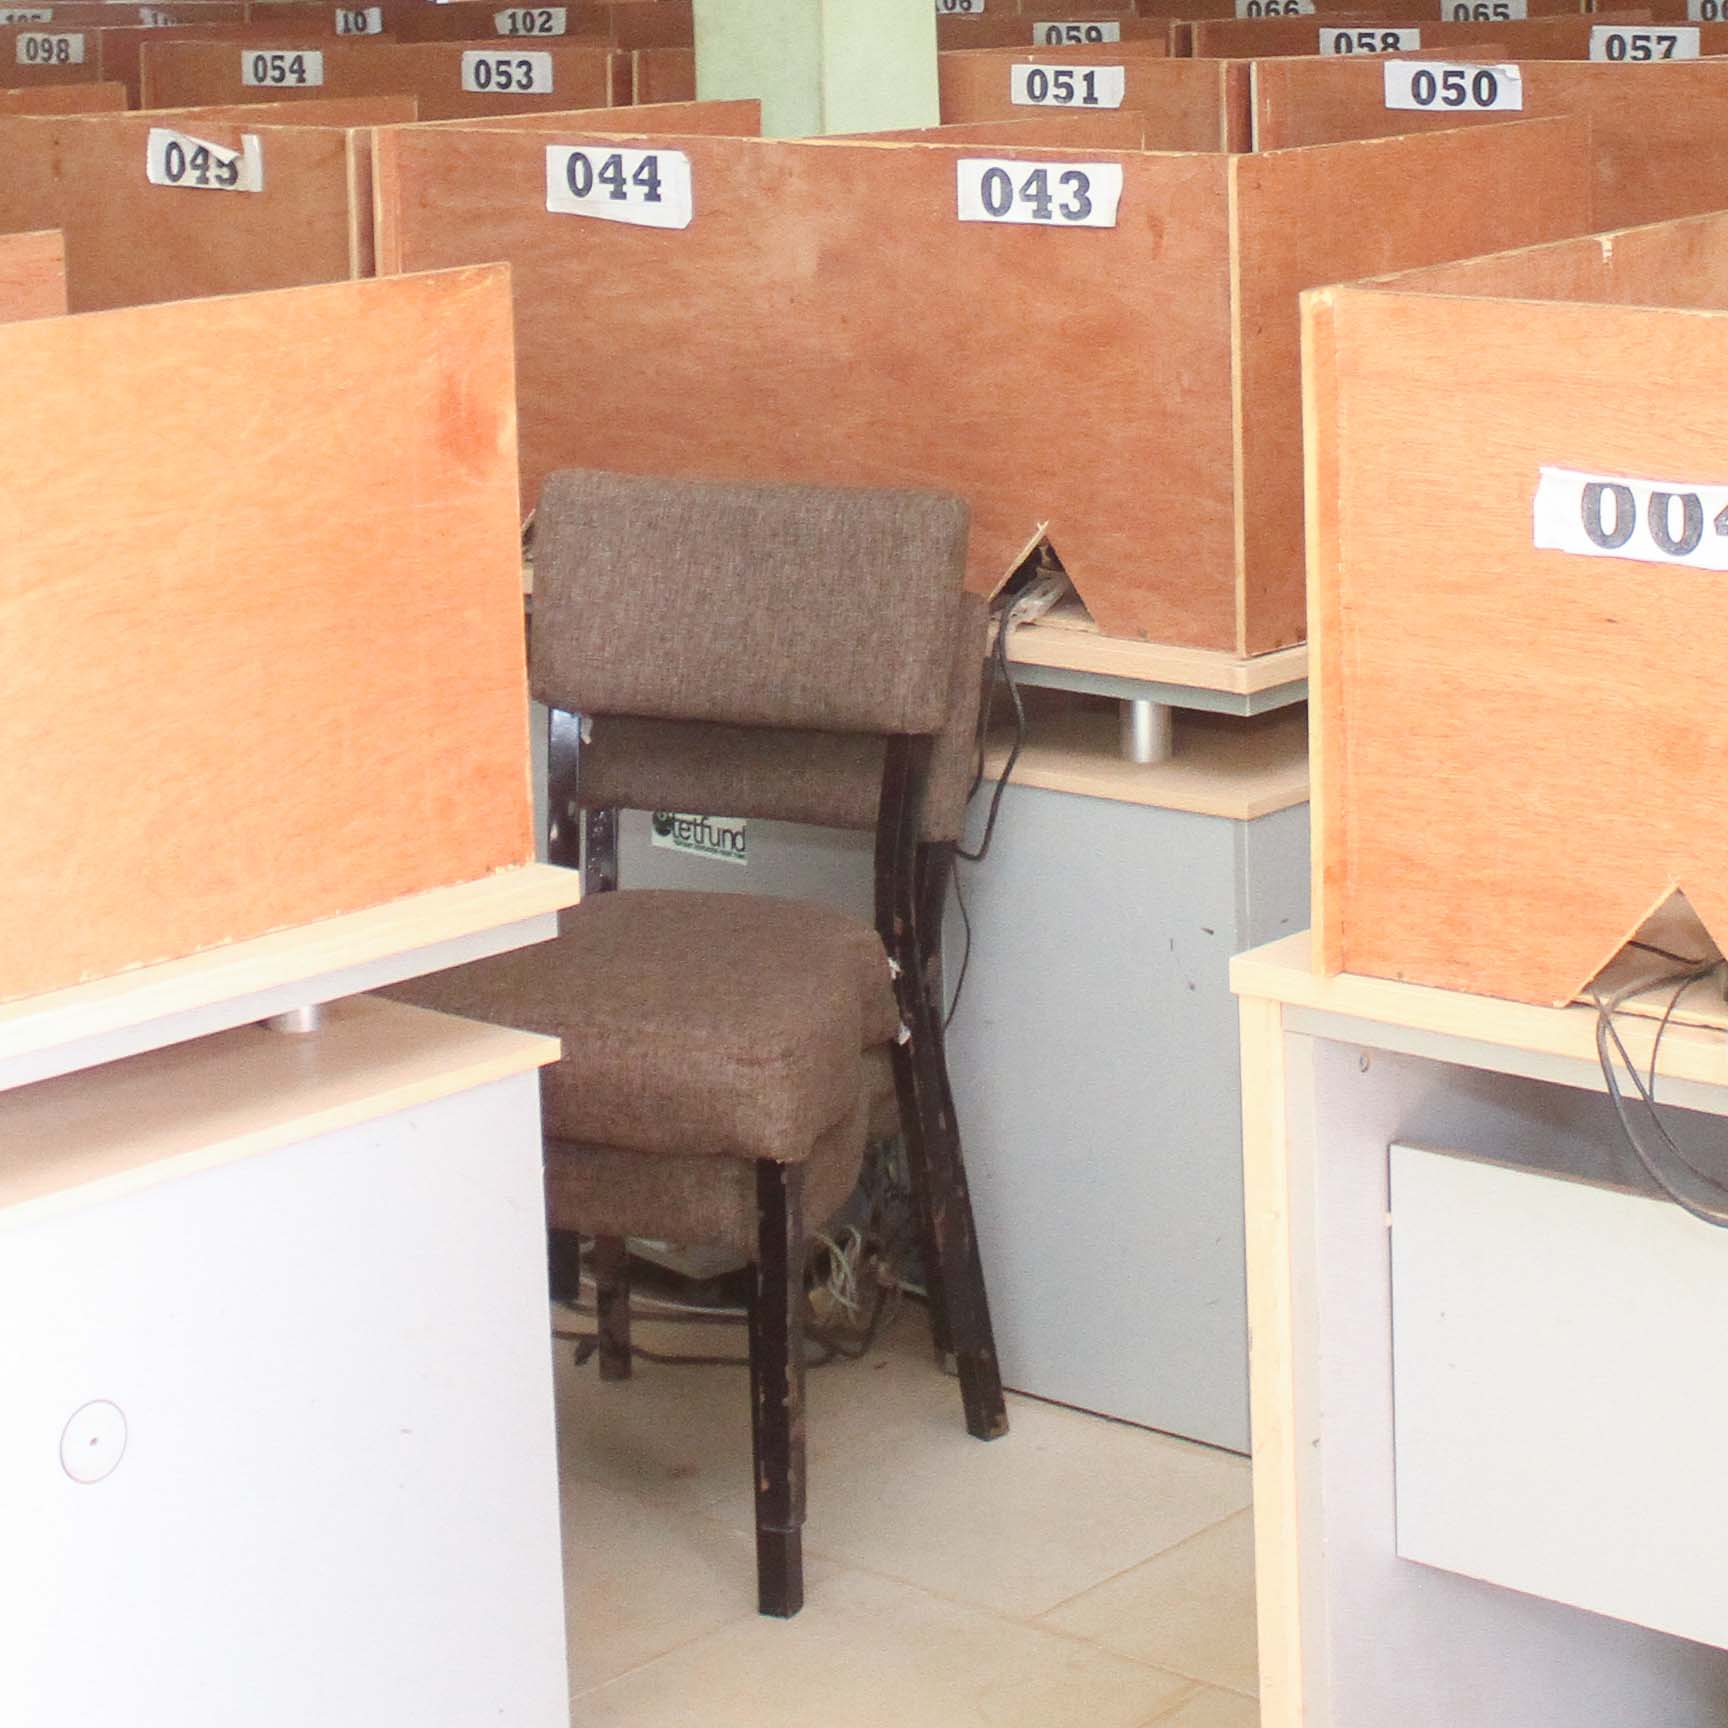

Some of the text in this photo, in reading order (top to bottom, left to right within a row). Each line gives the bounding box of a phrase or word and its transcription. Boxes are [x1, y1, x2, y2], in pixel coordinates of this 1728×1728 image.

[507, 10, 553, 34] 102
[1453, 2, 1510, 22] 065
[25, 38, 70, 63] 098
[1333, 31, 1400, 54] 058
[1605, 33, 1677, 61] 057
[253, 55, 307, 85] 054
[474, 59, 534, 91] 053
[1026, 68, 1100, 105] 051
[1411, 69, 1498, 108] 050
[566, 151, 662, 203] 044
[980, 166, 1093, 222] 043
